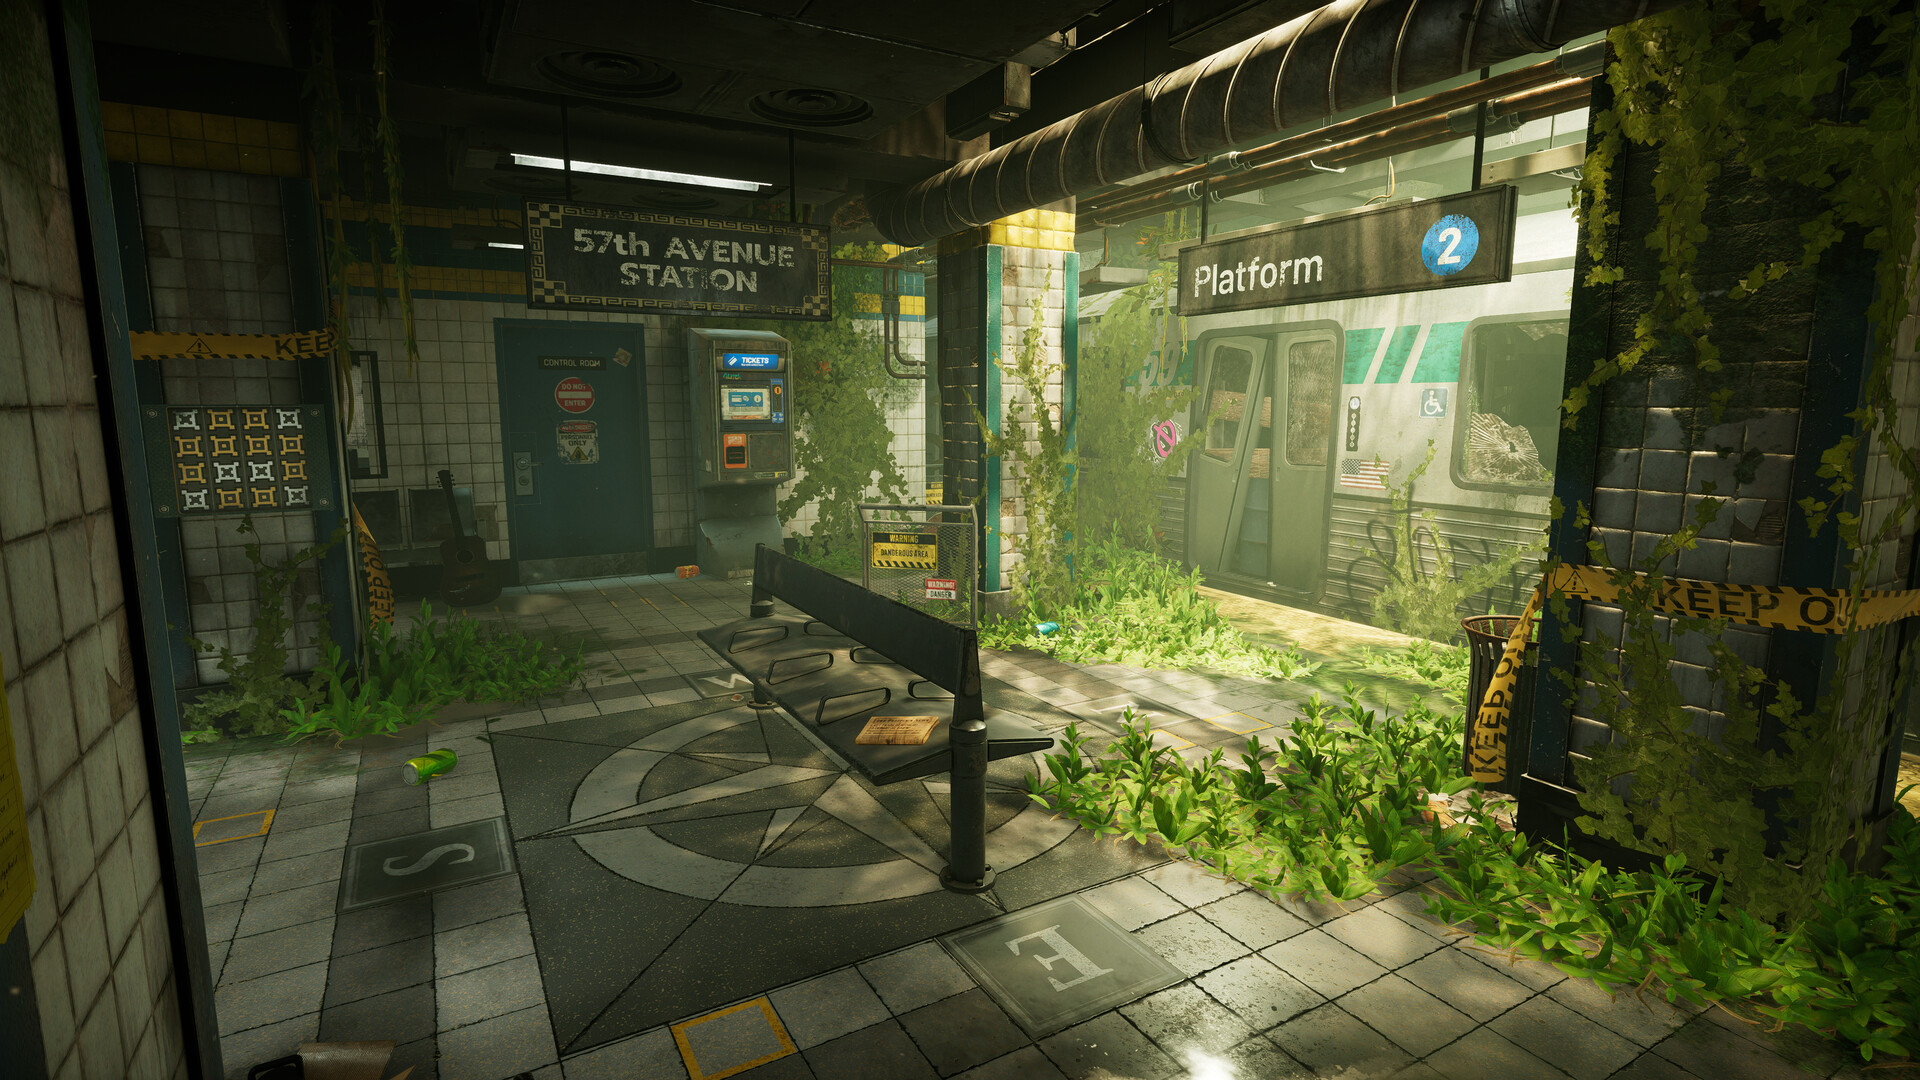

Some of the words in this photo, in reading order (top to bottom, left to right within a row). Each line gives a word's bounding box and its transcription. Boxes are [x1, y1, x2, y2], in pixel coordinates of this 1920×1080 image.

[573, 227, 650, 257] 57th
[664, 236, 795, 268] AVENUE
[1194, 255, 1323, 298] Platform
[1437, 227, 1462, 266] 2
[619, 262, 758, 293] STATION
[543, 358, 577, 367] CONTROL
[580, 359, 601, 367] ROOM
[561, 383, 572, 391] DO
[889, 534, 919, 544] WARNING
[880, 548, 913, 558] DANGEROUS
[914, 550, 929, 558] AREA
[927, 581, 956, 589] WARNING!
[930, 590, 953, 599] DANGER
[1656, 586, 1780, 619] KEEP
[382, 843, 476, 877] S
[1004, 924, 1115, 993] E
